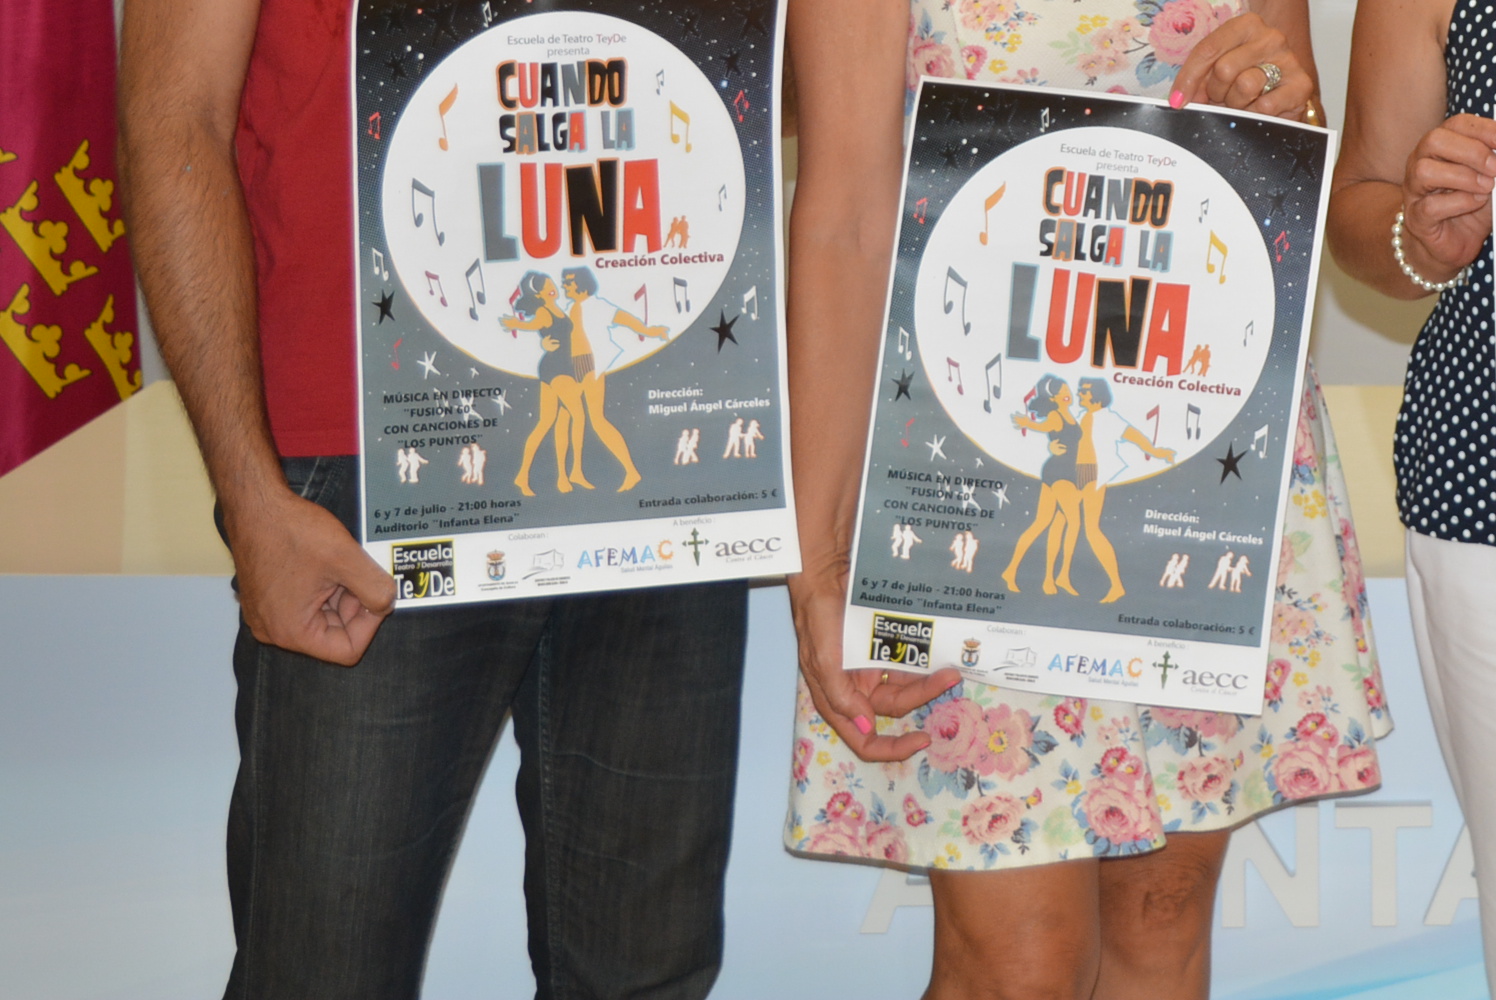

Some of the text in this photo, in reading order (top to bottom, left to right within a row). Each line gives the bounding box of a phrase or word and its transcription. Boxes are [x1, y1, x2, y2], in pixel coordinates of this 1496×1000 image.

[507, 32, 627, 47] Escuela de Teatro TeyDe
[547, 46, 590, 58] presenta
[496, 57, 628, 111] CUANDO
[499, 107, 634, 155] SALGA LA
[1060, 143, 1177, 168] Escuela de Teatro TeyDe
[1096, 160, 1139, 175] presenta
[1042, 166, 1174, 228] CUANDO
[477, 157, 662, 263] LUNA
[1039, 218, 1174, 272] SALGA LA
[595, 250, 724, 269] Creación Colectiva
[1006, 261, 1190, 377] LUNA
[648, 387, 703, 400] Dirección:
[1113, 371, 1242, 397] Creación Colectiva
[383, 387, 502, 404] MÚSICA EN DIRECTO
[648, 397, 771, 416] Miguel Ángel Cárceles
[384, 418, 498, 435] CON CANCIONES DE
[887, 468, 1003, 490] MÚSICA EN DIRECTO
[404, 506, 418, 516] de
[421, 503, 446, 517] julio
[458, 500, 487, 511] 21:00
[490, 499, 521, 509] horas
[638, 496, 682, 509] Entrada
[684, 490, 759, 506] colaboración:
[884, 499, 995, 519] CON CANCIONES DE
[1145, 509, 1200, 524] Dirección:
[374, 520, 429, 534] Auditorio
[1143, 524, 1264, 546] Miguel Ángel Cárceles
[393, 544, 453, 563] Escuela
[577, 539, 674, 569] AFEMAC
[714, 536, 781, 558] aecc
[860, 592, 913, 606] Auditorio
[891, 580, 905, 590] de
[907, 582, 932, 593] julio
[943, 586, 972, 597] 21:00
[976, 588, 1005, 600] horas
[874, 616, 932, 638] Escuela
[1118, 614, 1160, 627] Entrada
[1162, 618, 1236, 634] colaboración:
[1047, 654, 1143, 678] AFEMAC
[1182, 667, 1249, 690] aecc
